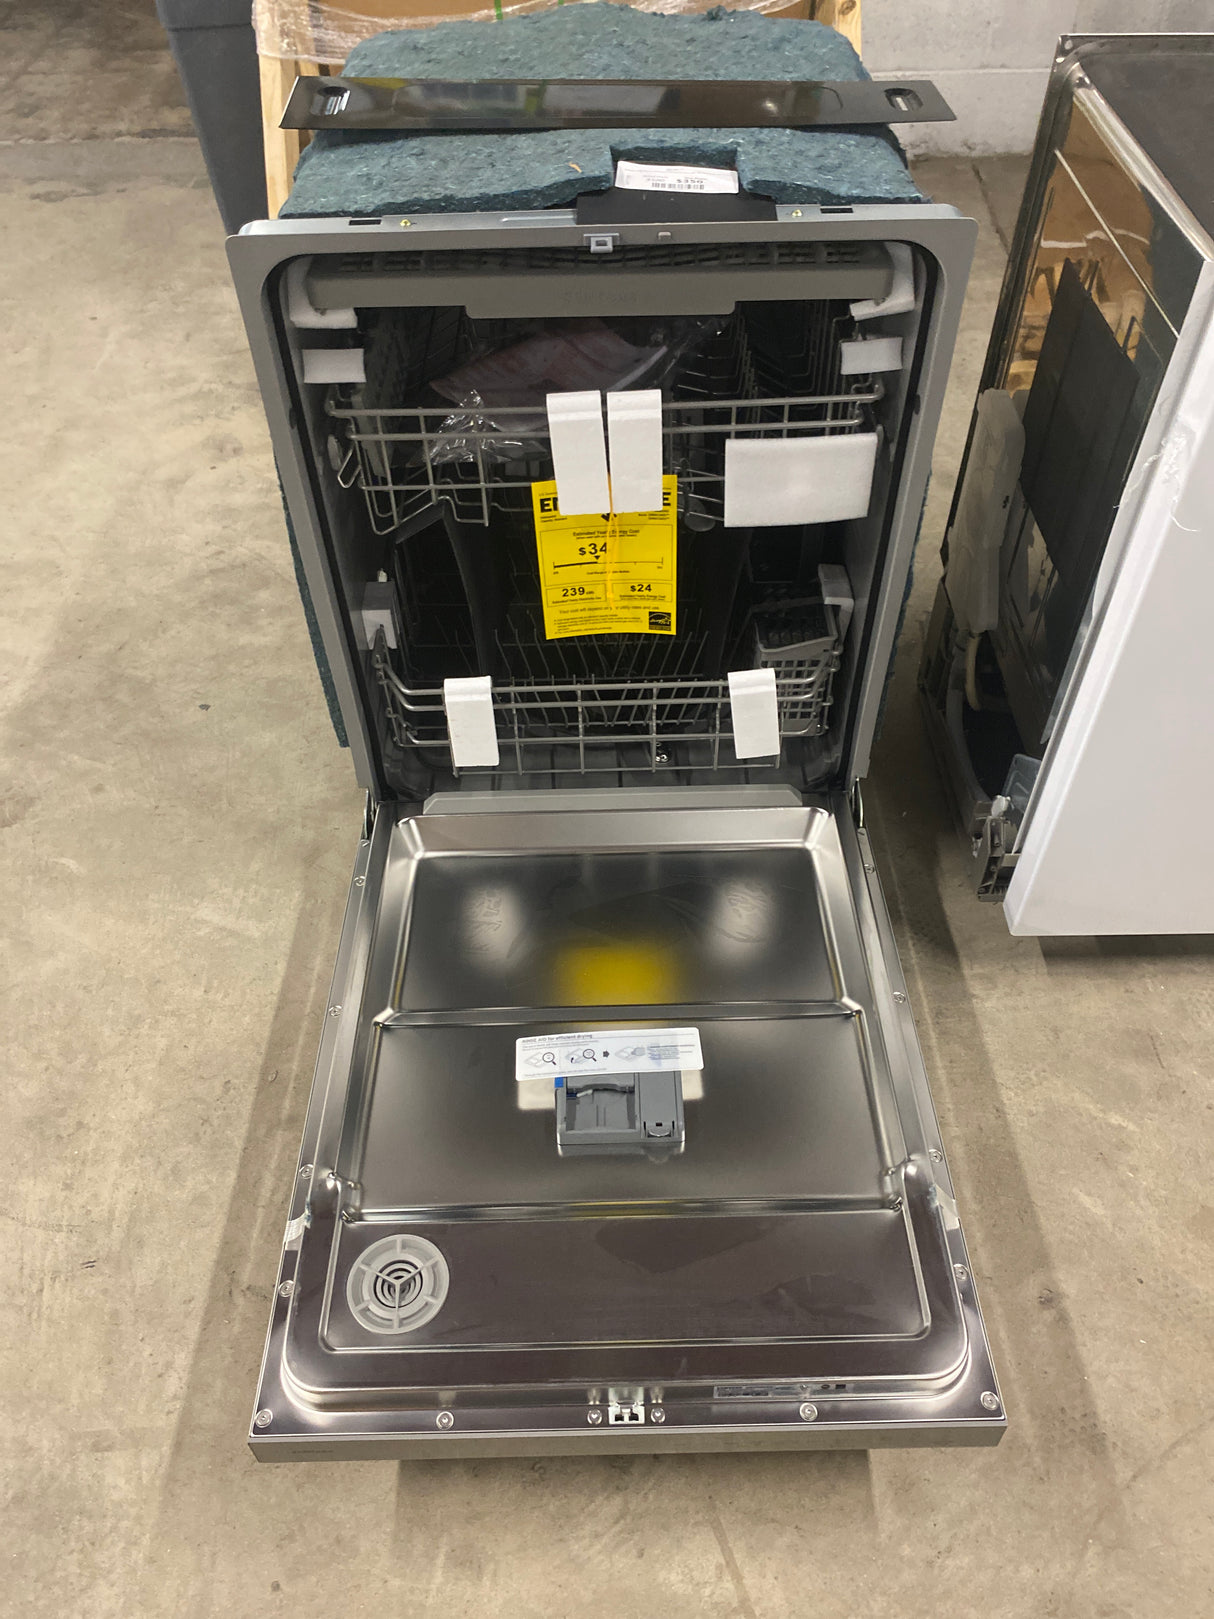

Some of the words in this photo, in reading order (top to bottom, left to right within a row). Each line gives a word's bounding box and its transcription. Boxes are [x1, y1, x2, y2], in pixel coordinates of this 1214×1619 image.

[578, 542, 607, 556] $34
[562, 586, 585, 597] 239
[630, 583, 652, 593] $24
